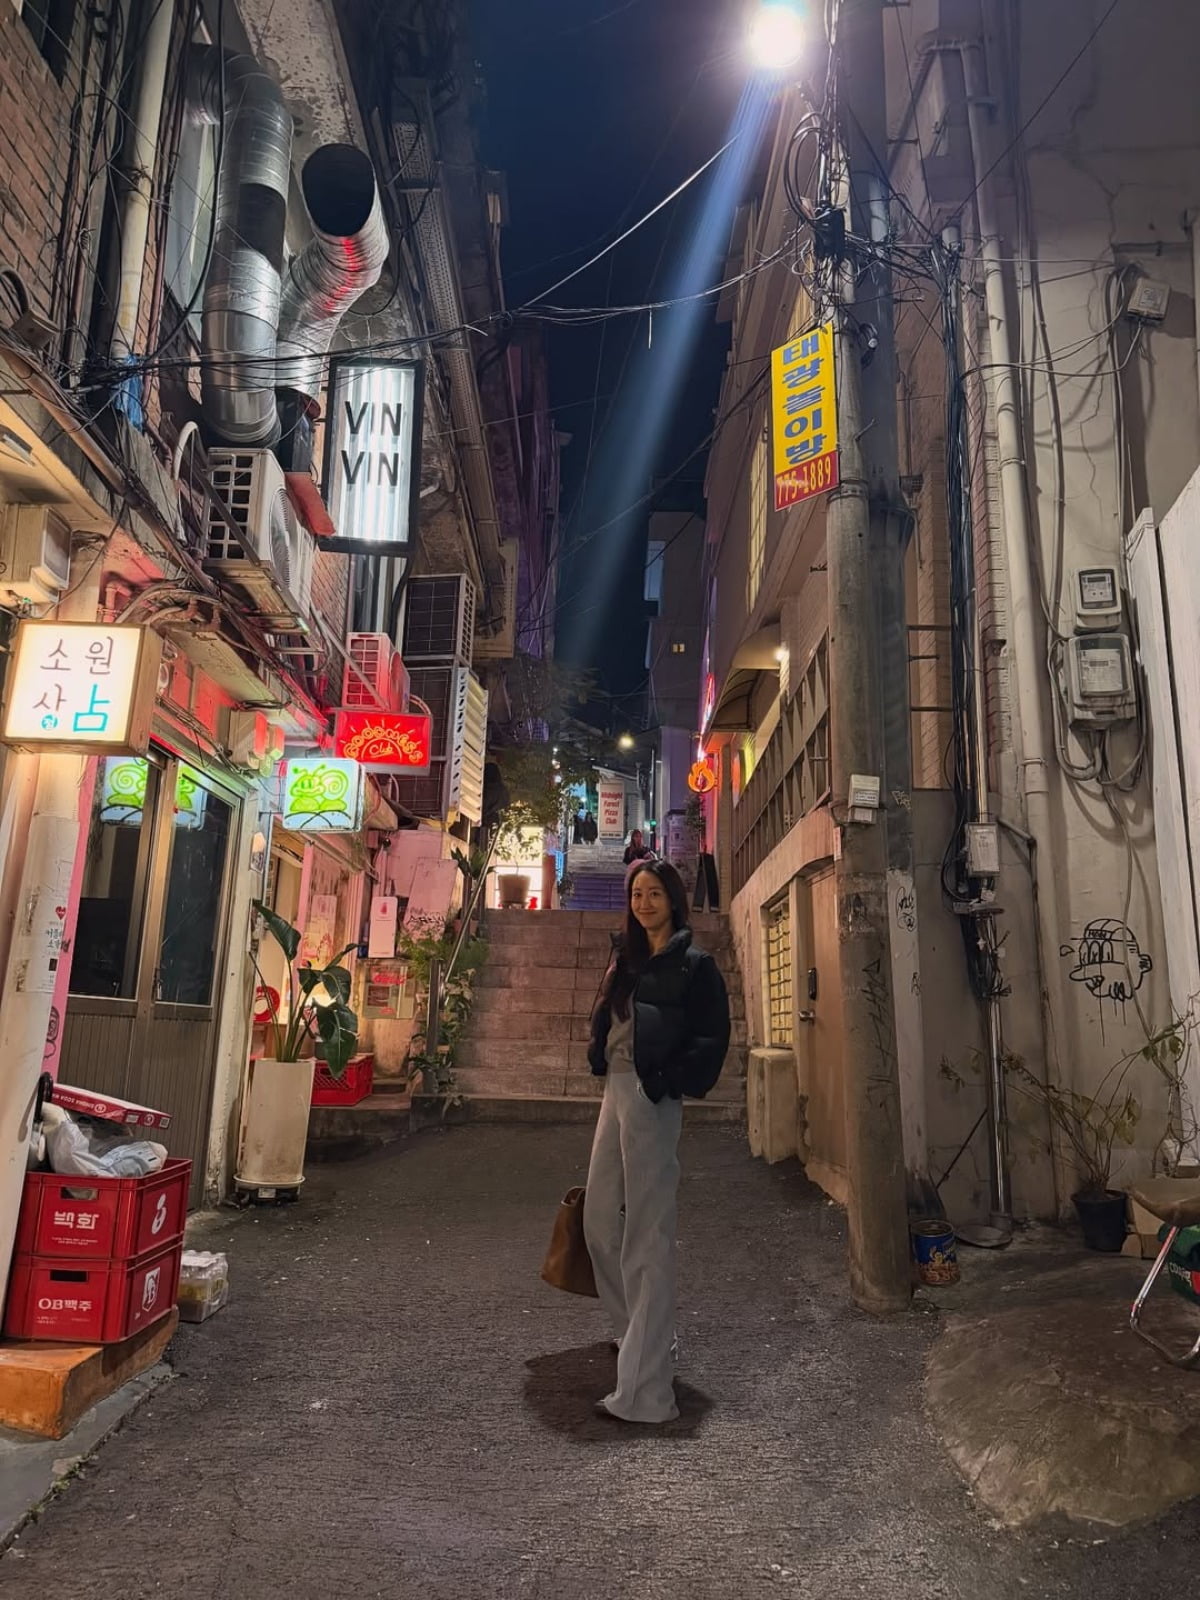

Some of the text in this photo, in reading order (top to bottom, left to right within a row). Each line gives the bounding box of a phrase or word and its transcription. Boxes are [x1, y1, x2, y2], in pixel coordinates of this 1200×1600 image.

[344, 400, 402, 436] VIN
[782, 333, 828, 465] 태광놀이방
[341, 449, 399, 487] VIN
[776, 456, 832, 505] 775-1889
